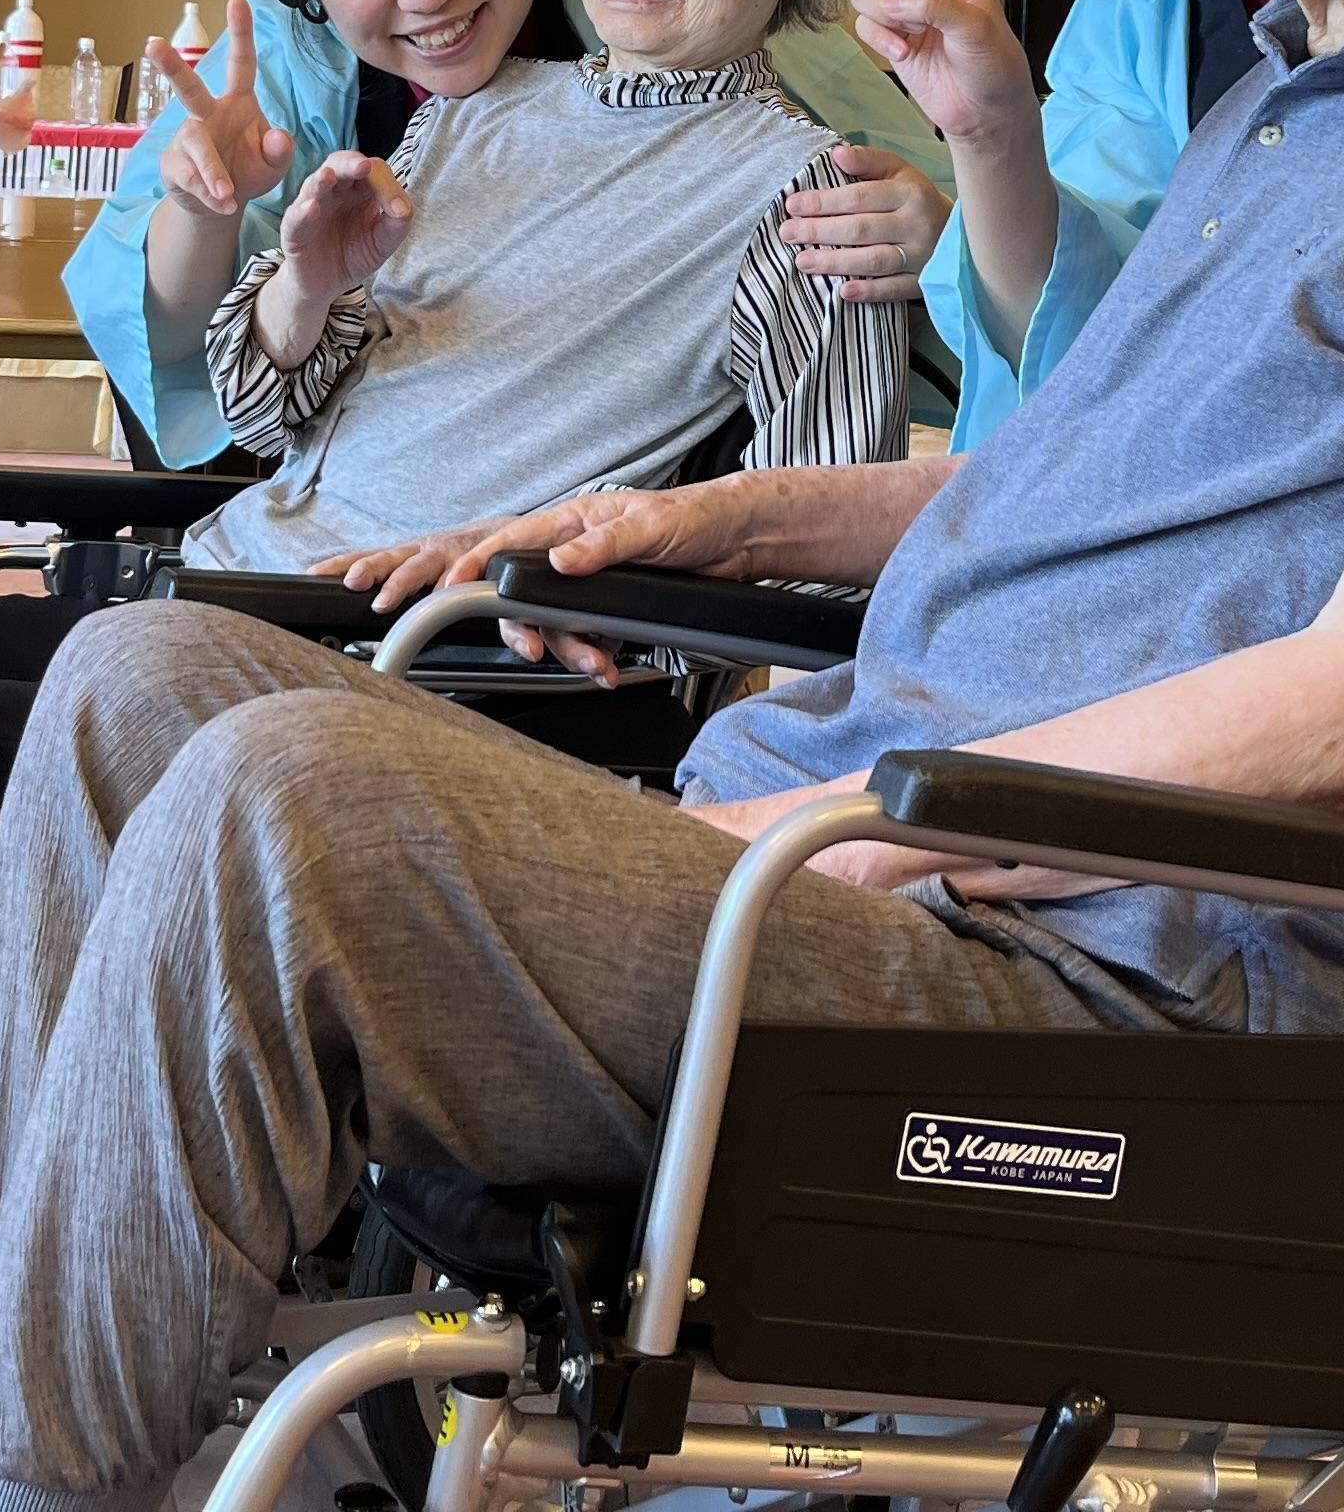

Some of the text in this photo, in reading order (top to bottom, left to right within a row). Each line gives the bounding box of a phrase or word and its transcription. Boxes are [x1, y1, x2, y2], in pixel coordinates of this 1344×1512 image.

[955, 1134, 1117, 1172] KAWAMURA
[991, 1165, 1073, 1183] KOBE JAPAN
[784, 1443, 810, 1468] M
